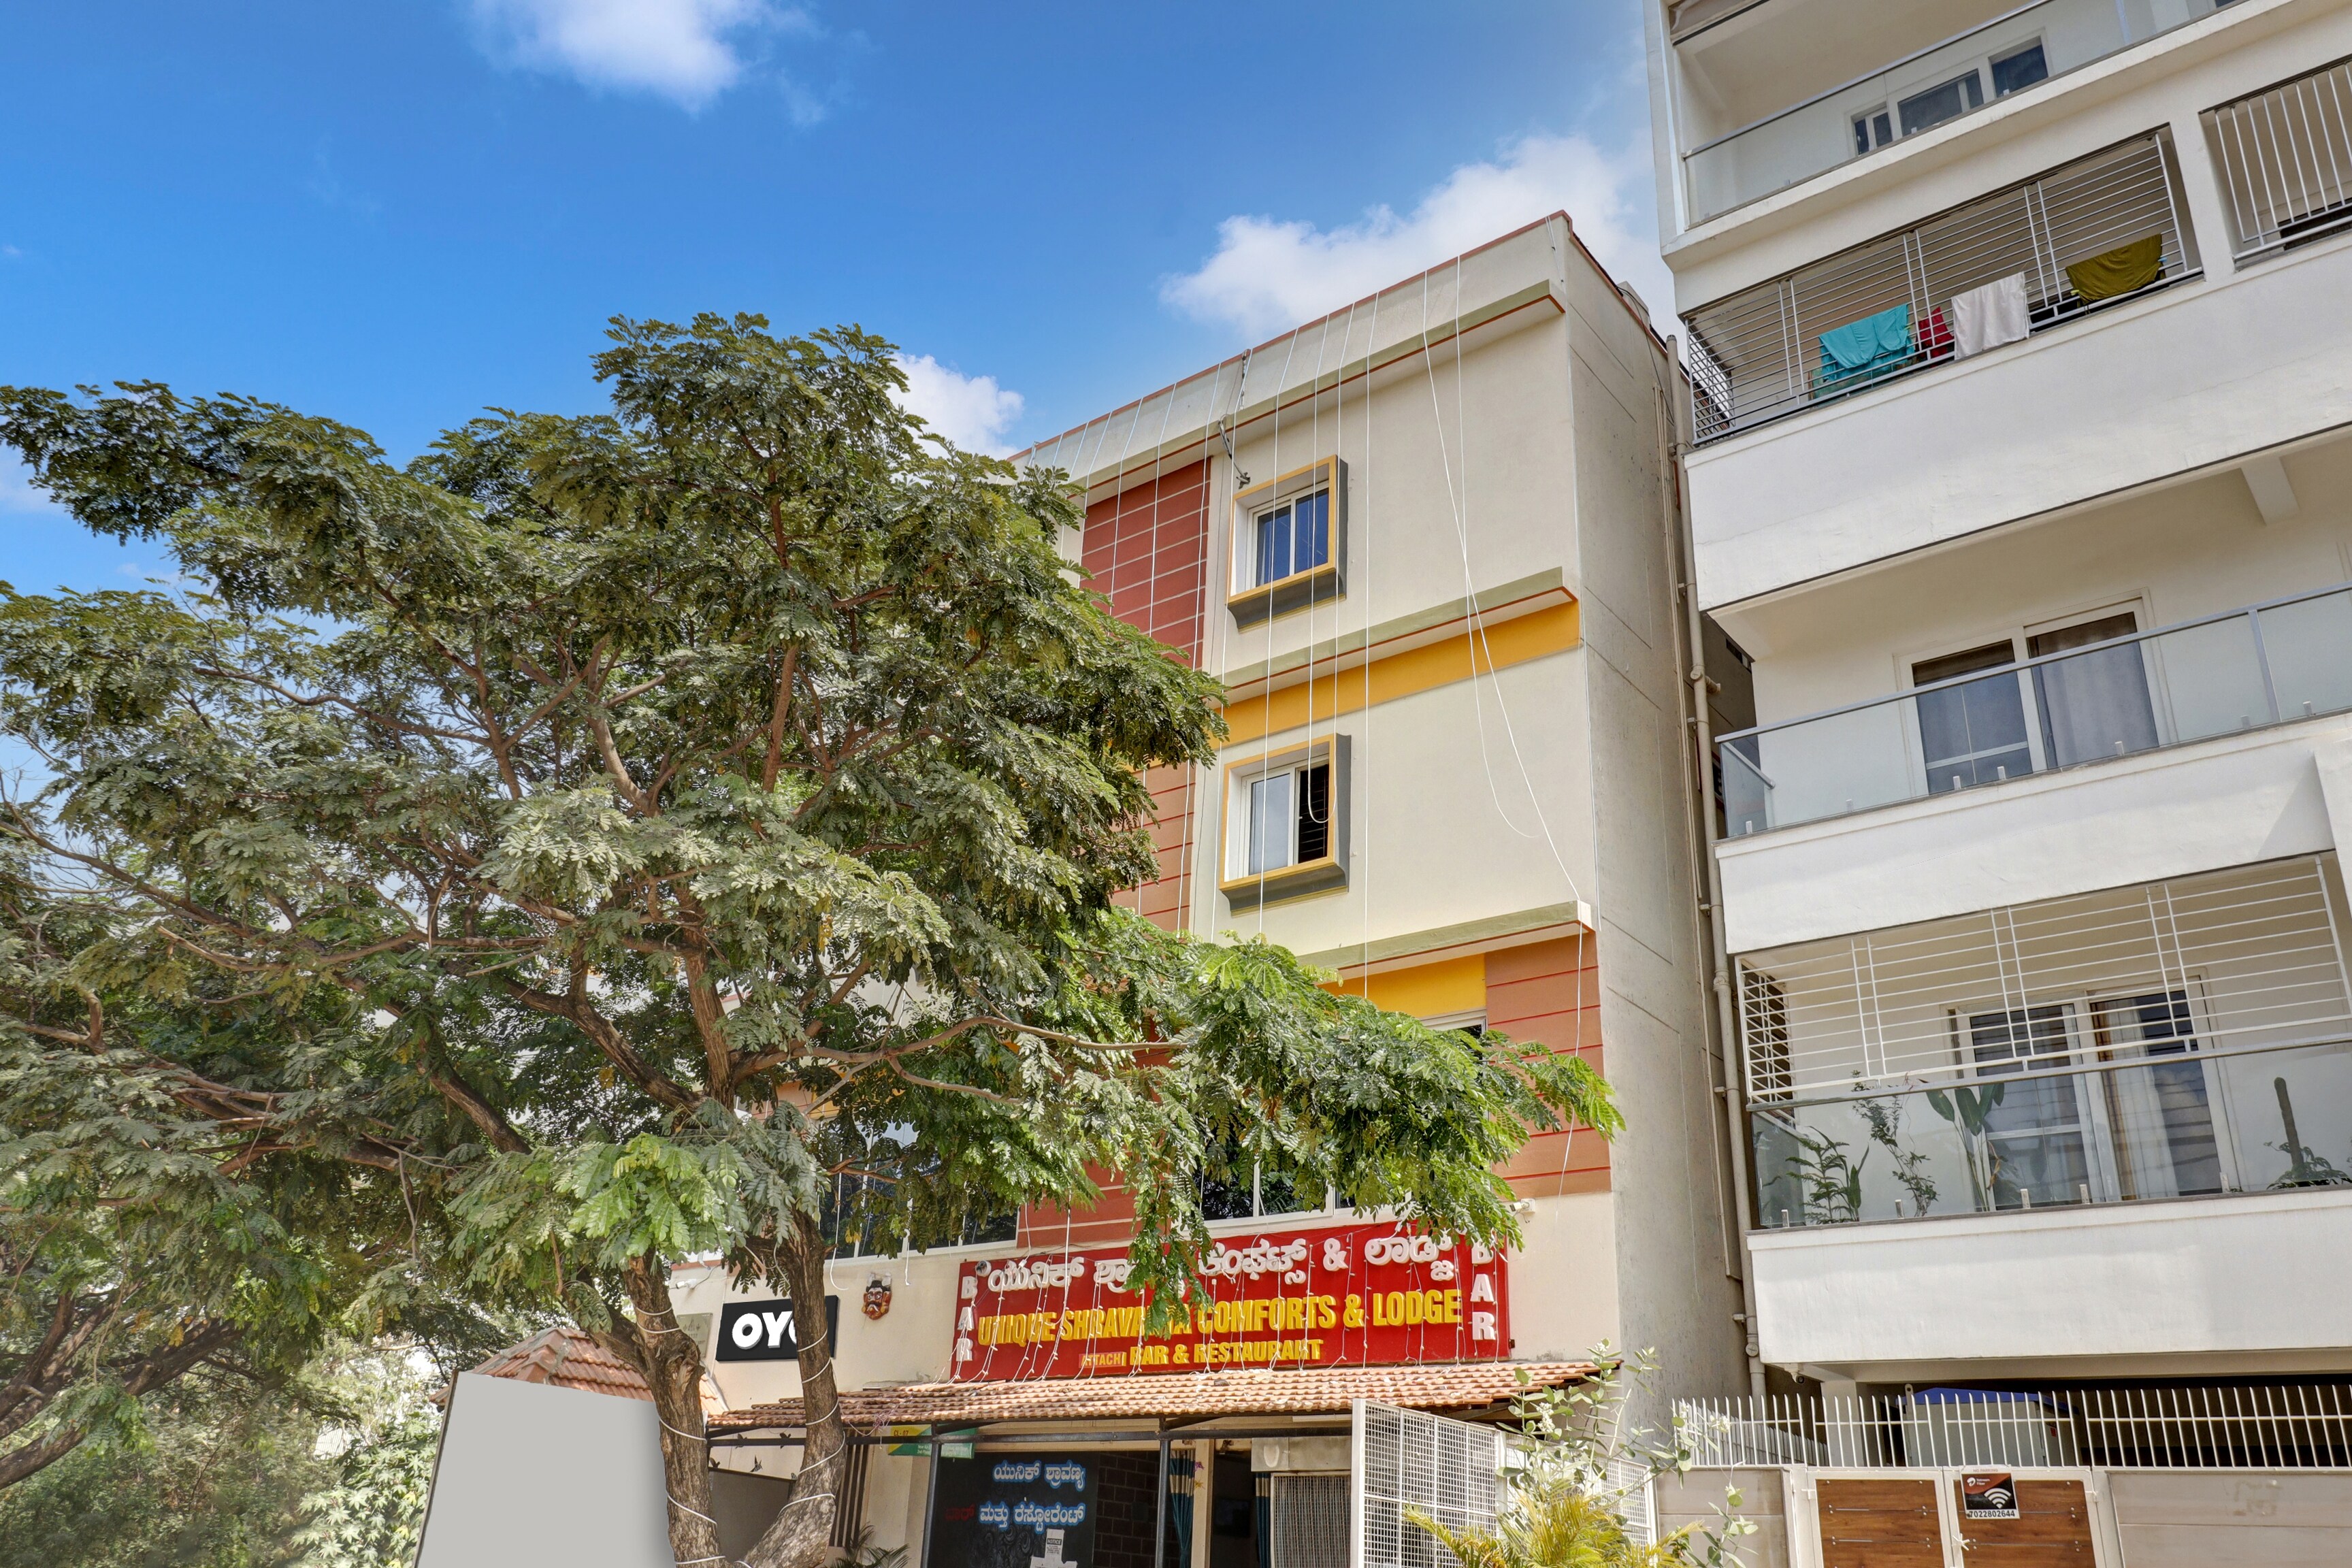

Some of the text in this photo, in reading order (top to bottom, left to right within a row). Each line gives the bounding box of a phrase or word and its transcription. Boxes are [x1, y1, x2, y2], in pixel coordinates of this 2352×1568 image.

[1323, 1238, 1348, 1271] &
[1471, 1238, 1496, 1340] BAR
[732, 1311, 797, 1350] OY
[956, 1276, 978, 1362] BAR
[978, 1289, 1462, 1347] UNIQUE SHRAVAA COMFORTS & LODGE
[1130, 1345, 1169, 1365] BAR
[1173, 1343, 1190, 1360] &
[1194, 1339, 1324, 1363] RESTAURANT
